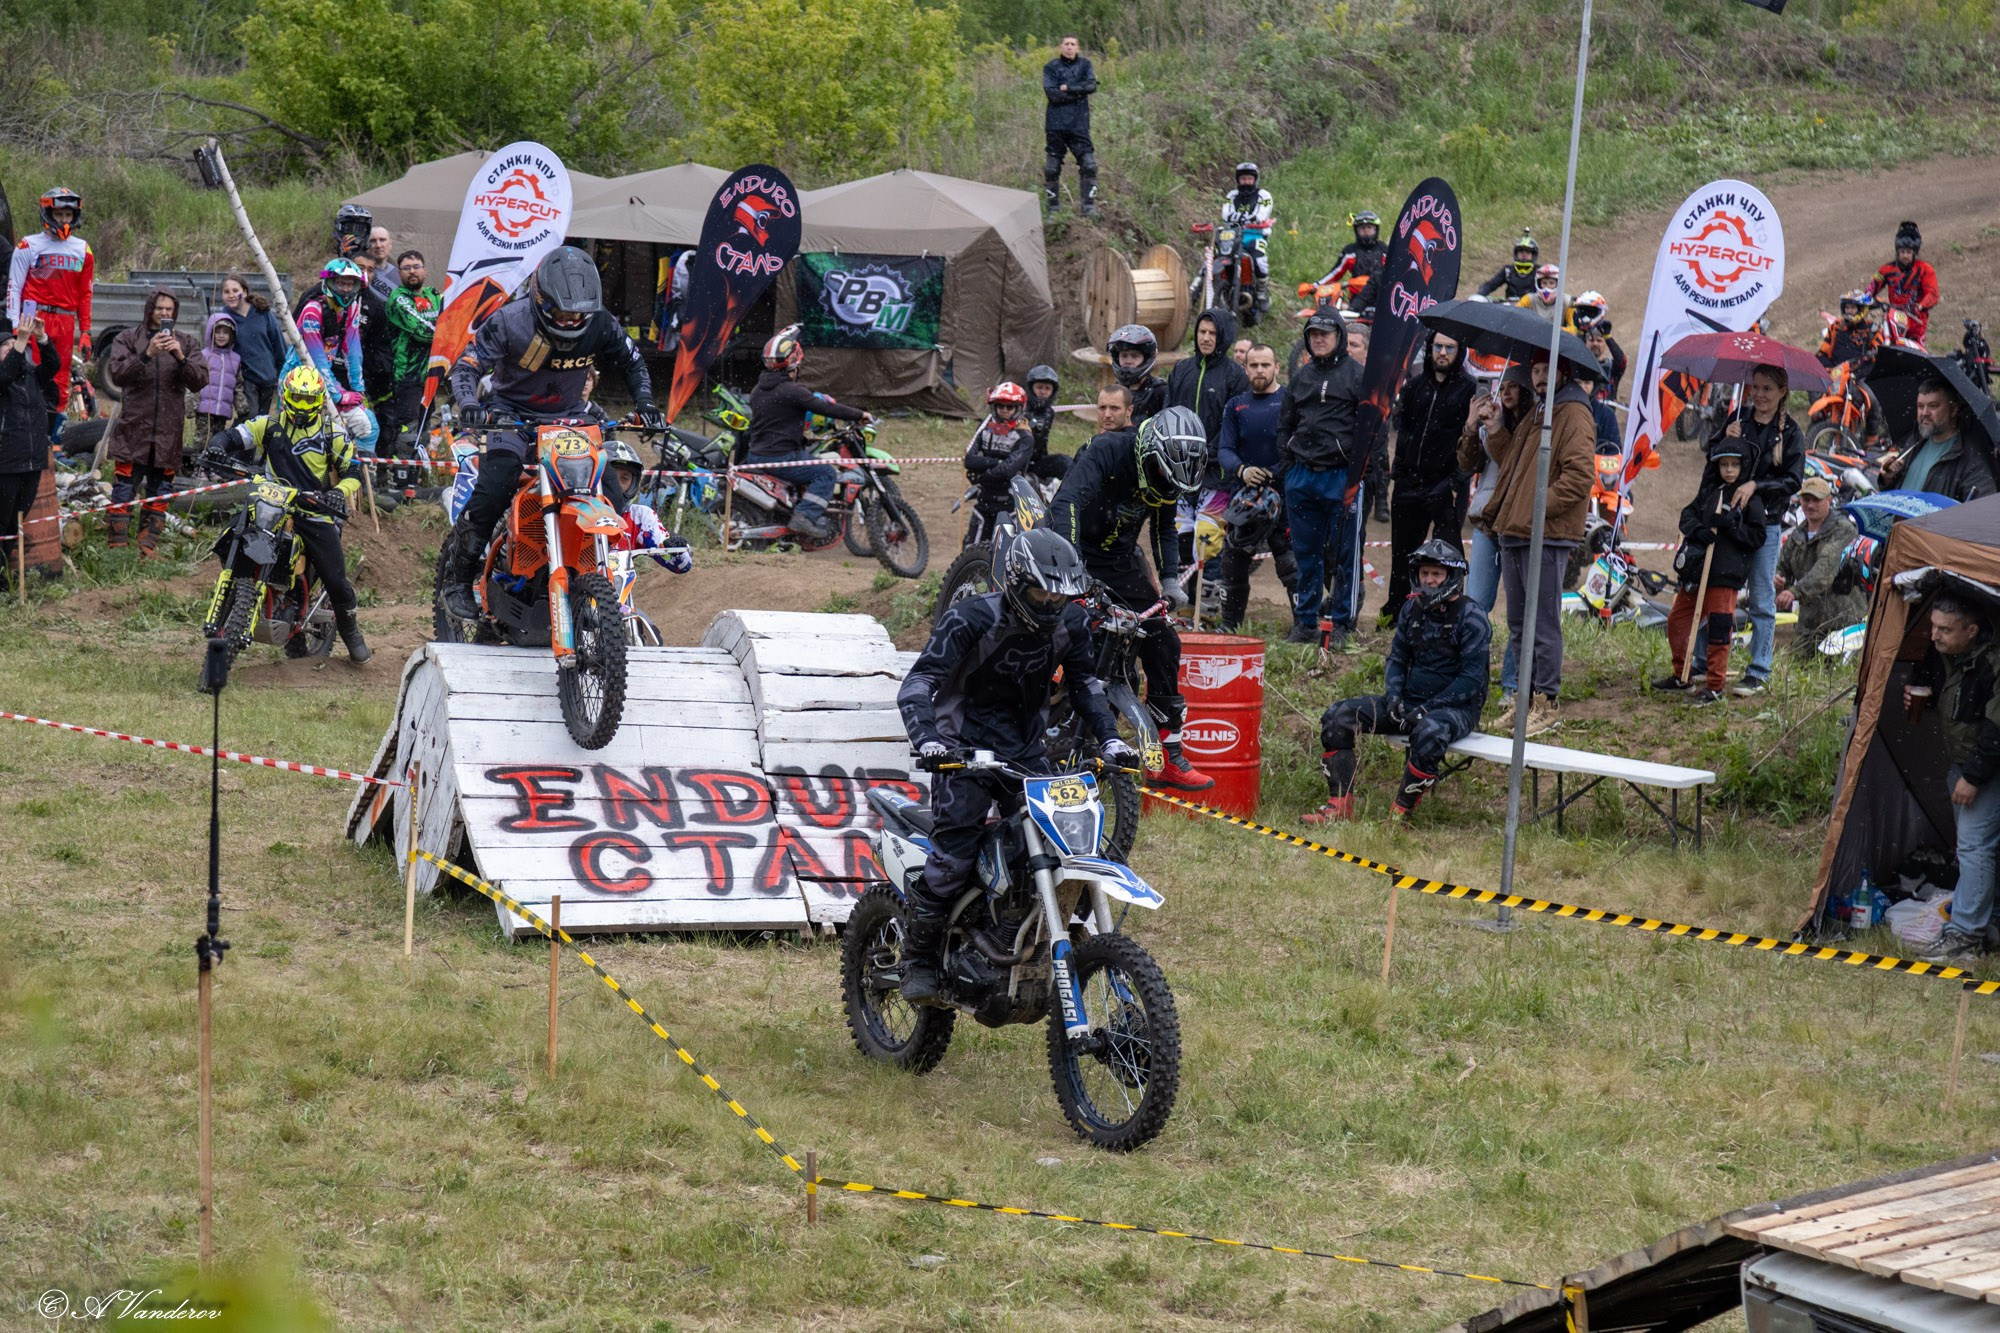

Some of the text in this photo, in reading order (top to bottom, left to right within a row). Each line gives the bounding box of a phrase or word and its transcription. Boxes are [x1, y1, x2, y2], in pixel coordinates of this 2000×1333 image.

[487, 154, 557, 185] СТАНКИ ЧПУ
[474, 195, 562, 220] HYPERCUT
[719, 174, 796, 218] ENDURO
[1399, 195, 1457, 251] ENDURO
[1683, 193, 1766, 230] СТАНКИ ЧПУ
[476, 220, 551, 250] ДЛЯ РЕЗКИ МЕТАЛЛА
[41, 255, 79, 268] LEATT
[1669, 242, 1775, 270] HYPERCUT
[1673, 273, 1764, 309] ДЛЯ РЕЗКИ МЕТАЛЛА
[563, 439, 581, 450] 73
[267, 488, 279, 499] 19
[1182, 730, 1237, 741] SINTEC
[1059, 787, 1080, 800] 62
[1052, 959, 1078, 1022] PROGASI
